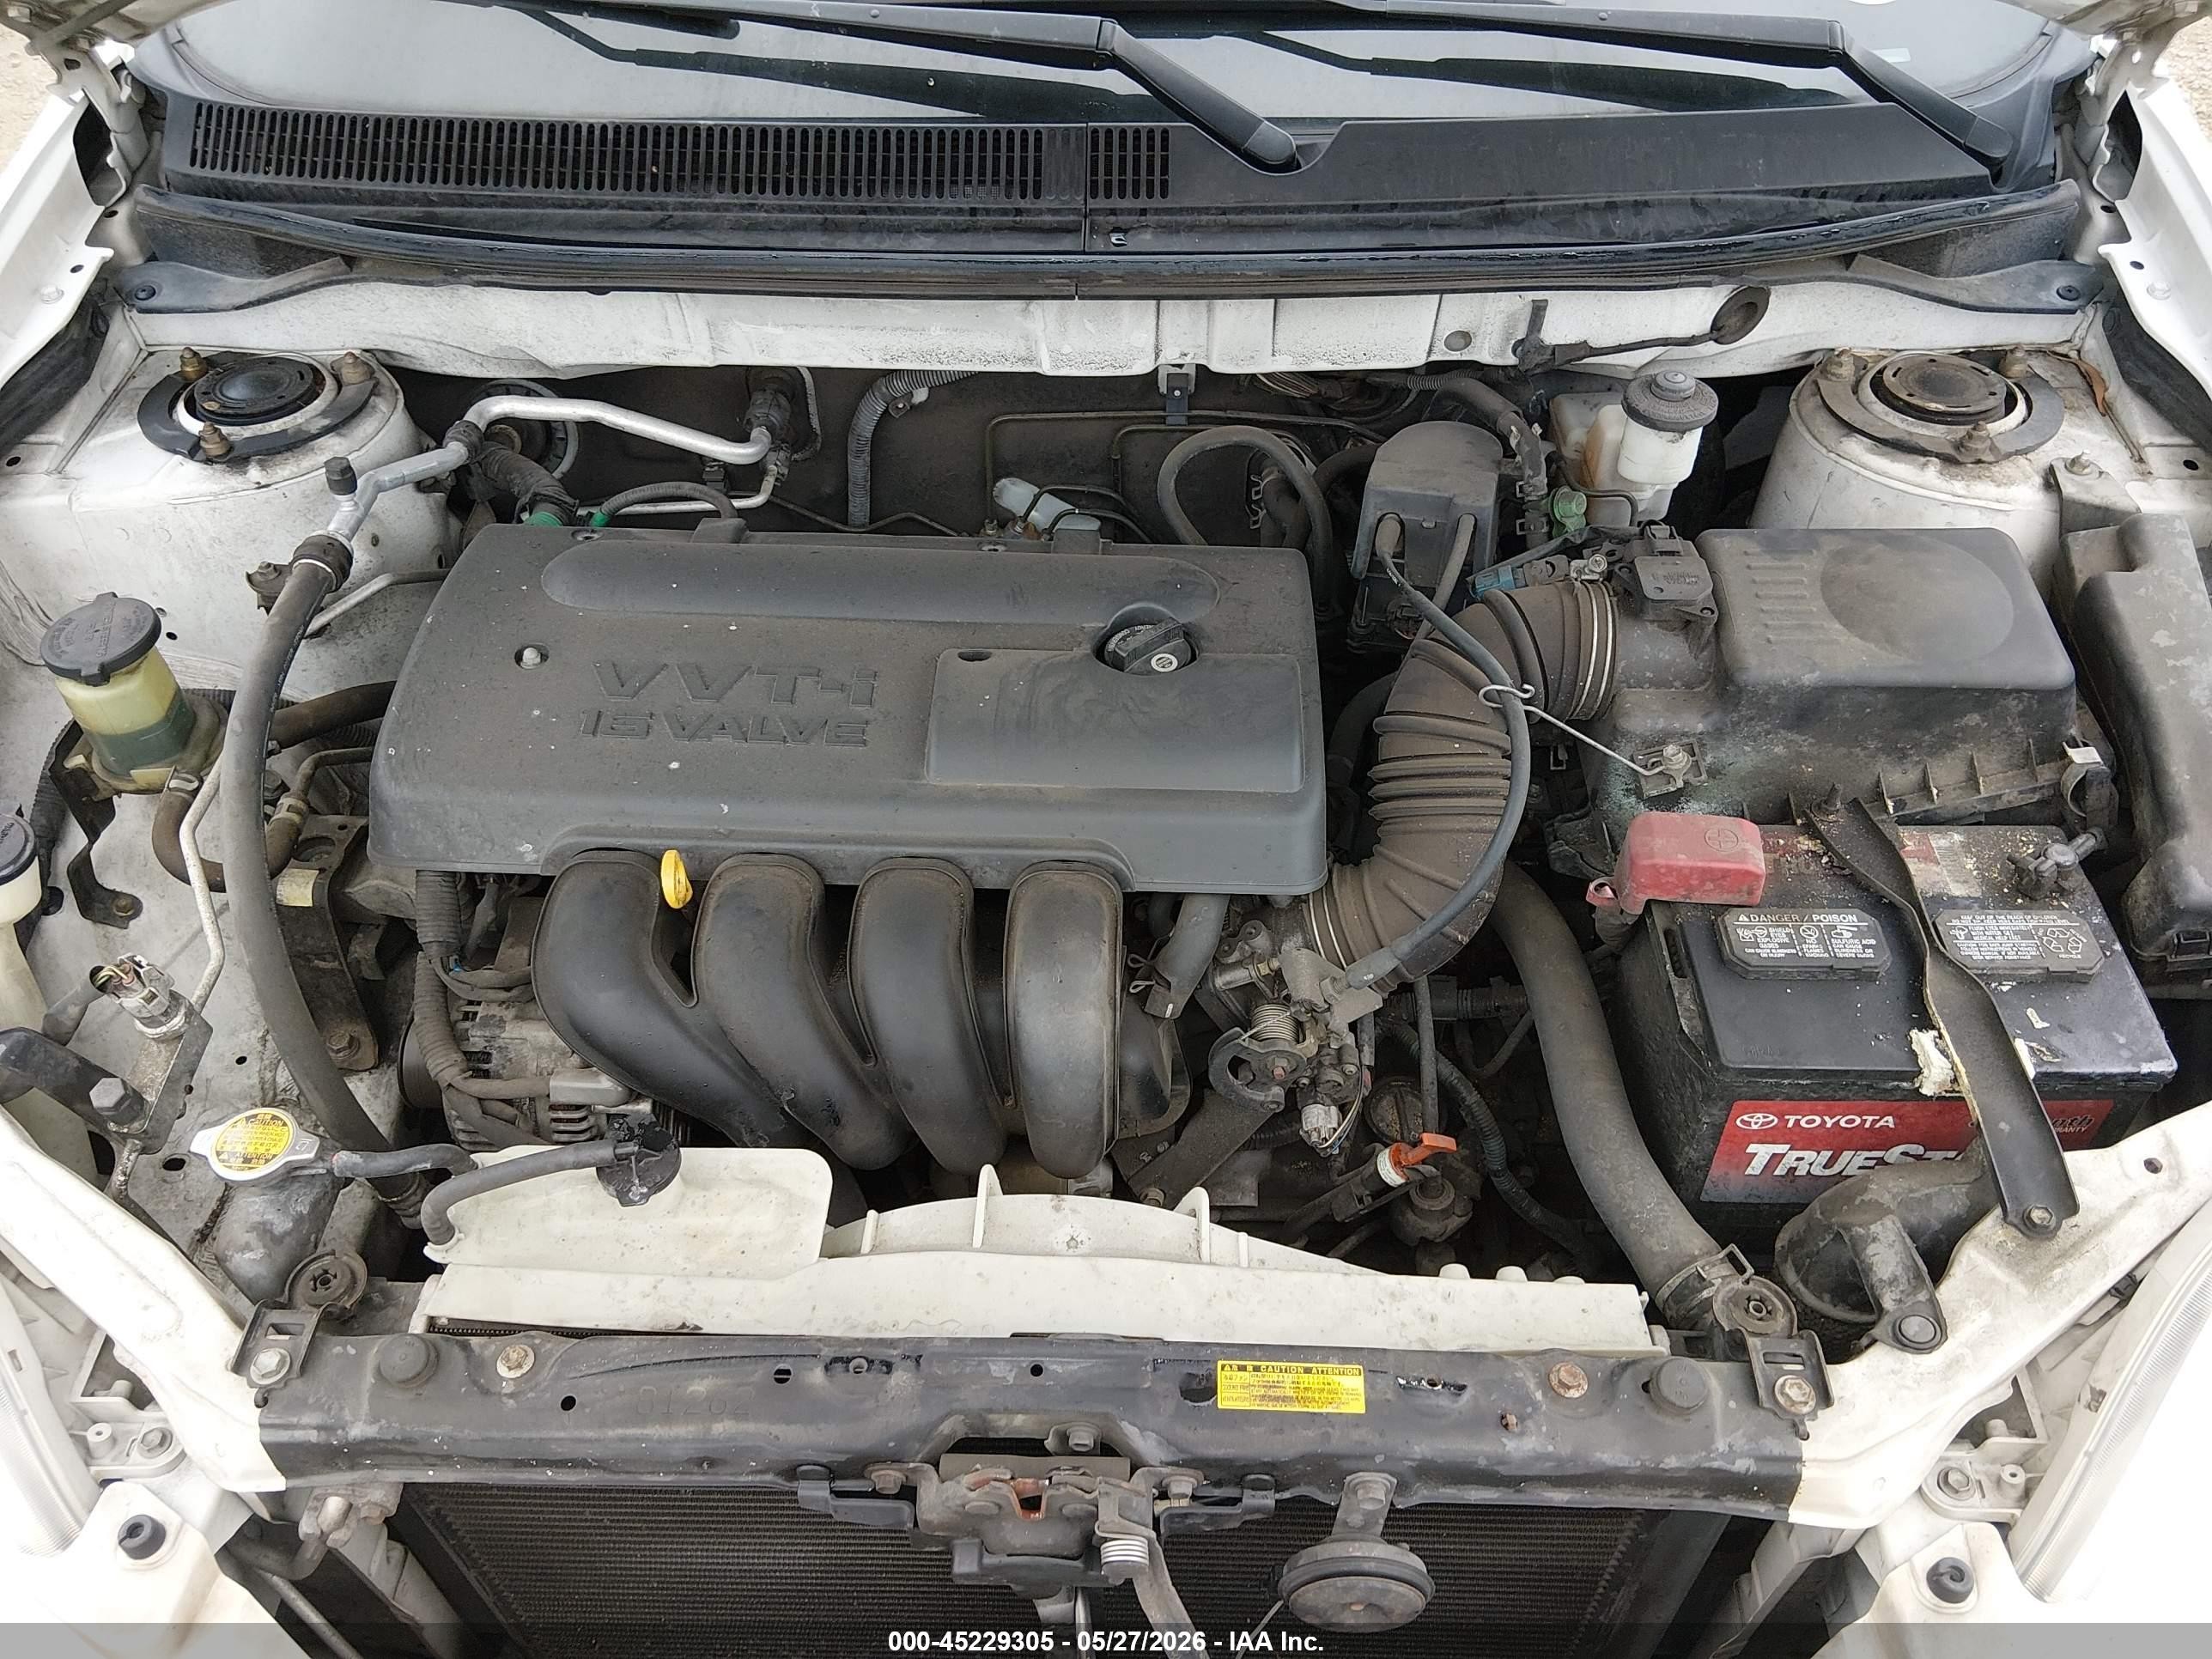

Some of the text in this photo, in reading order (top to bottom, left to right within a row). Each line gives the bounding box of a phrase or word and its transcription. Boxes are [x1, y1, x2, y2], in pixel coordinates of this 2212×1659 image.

[592, 661, 878, 708] VVT-i
[580, 709, 870, 748] 16 VALVE
[1750, 914, 1800, 922] DANGER
[1813, 914, 1857, 922] POISON
[248, 1118, 284, 1127] CAUTION
[1784, 1115, 1895, 1129] TOYOTA
[1260, 1365, 1304, 1374] CAUTION
[1311, 1367, 1360, 1376] ATTENTION
